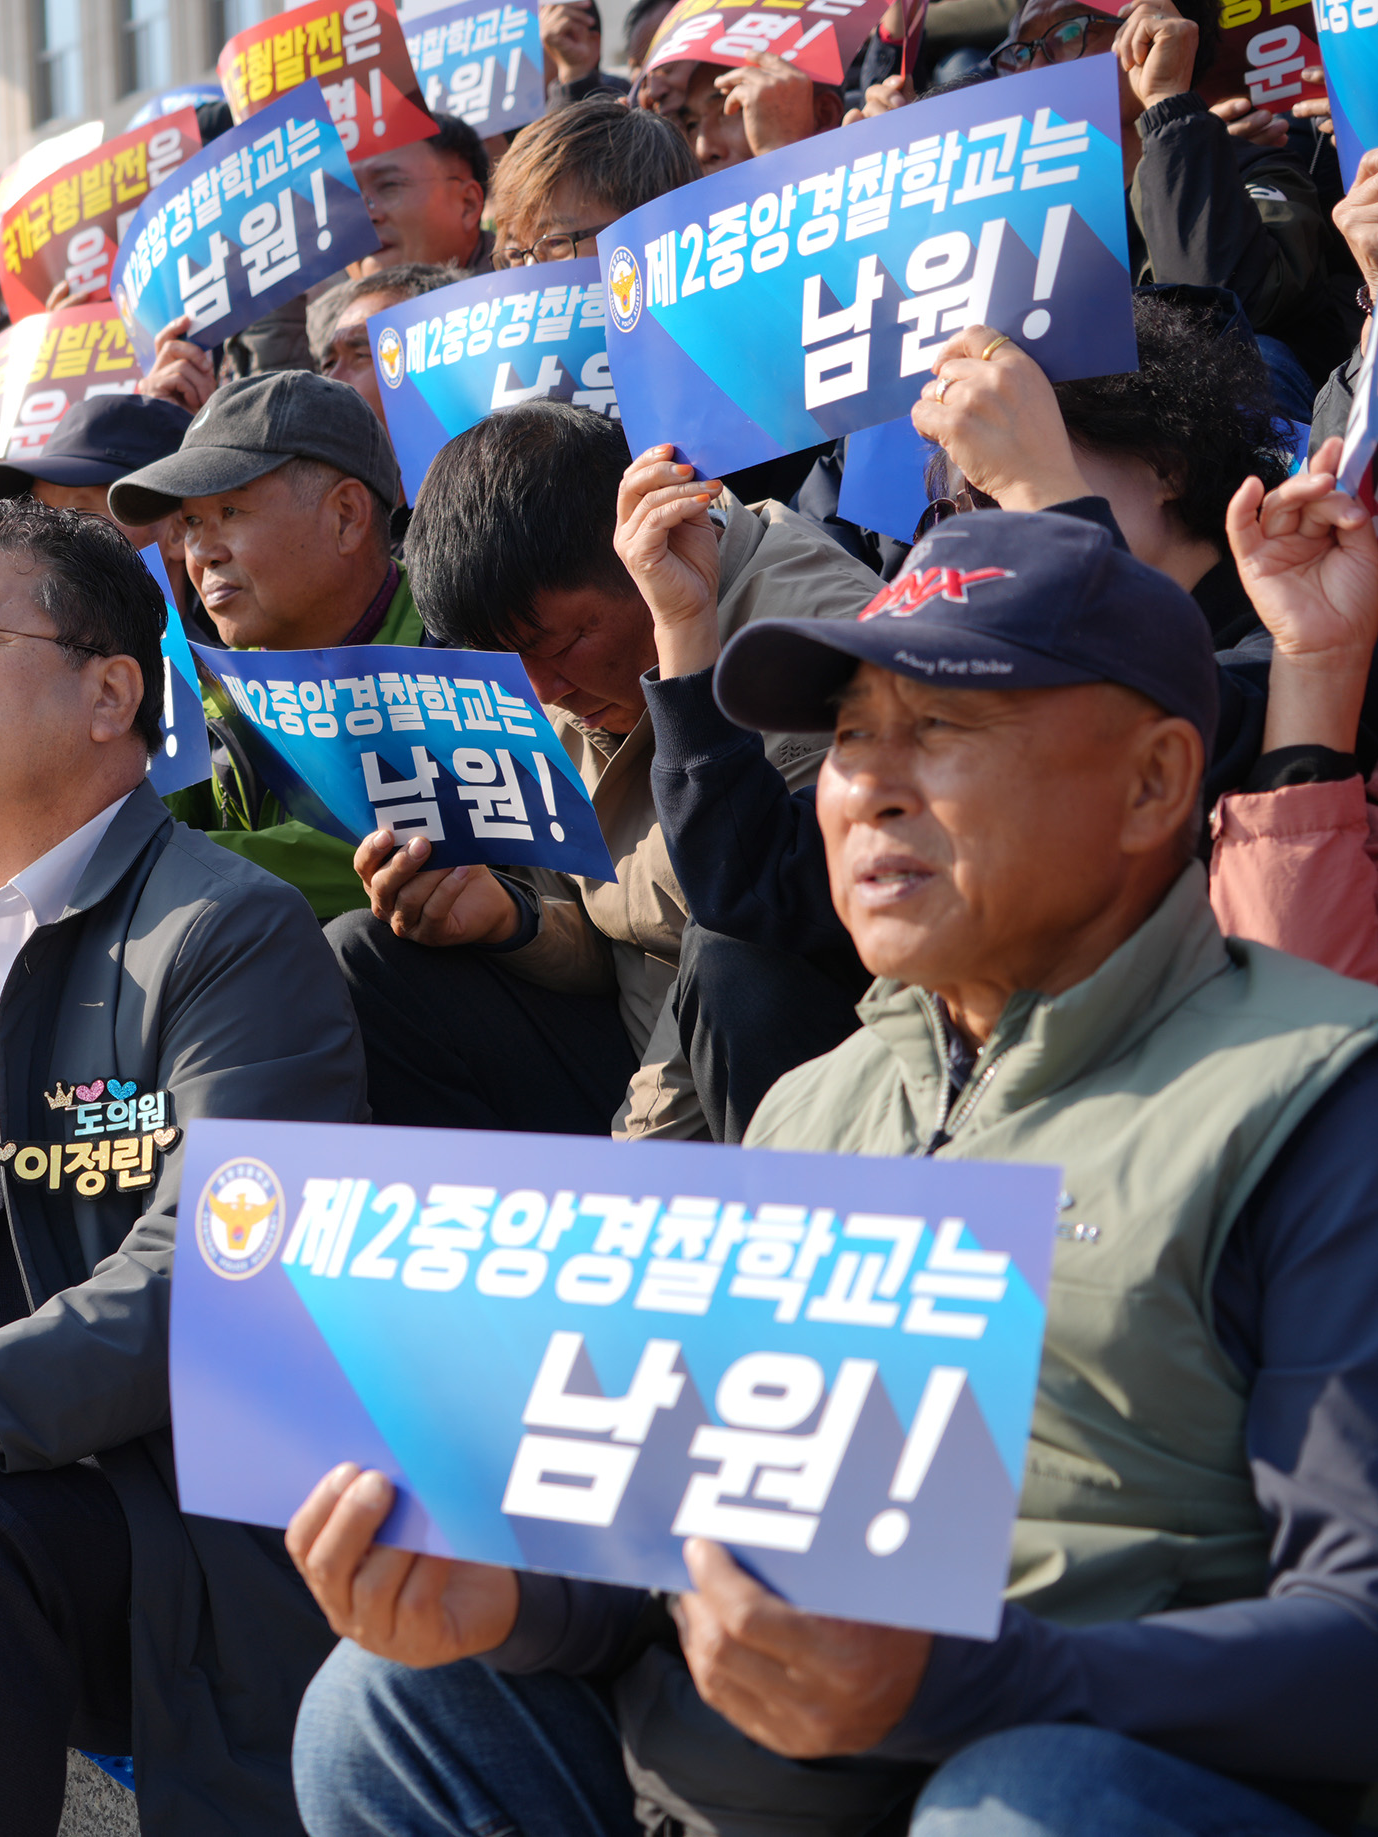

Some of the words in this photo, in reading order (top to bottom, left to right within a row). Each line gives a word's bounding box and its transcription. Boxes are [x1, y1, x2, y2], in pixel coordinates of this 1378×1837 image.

[177, 168, 333, 338] 남원!
[644, 107, 1089, 308] 제2중앙경찰학교는
[802, 203, 1072, 410] 남원!
[221, 672, 537, 739] 제2중앙경찰학교는
[361, 745, 566, 848] 남원!
[13, 1134, 154, 1197] 이정린
[74, 1091, 166, 1137] 도의원
[280, 1177, 1011, 1340] 제2중앙경찰학교는
[501, 1330, 969, 1558] 남원!
